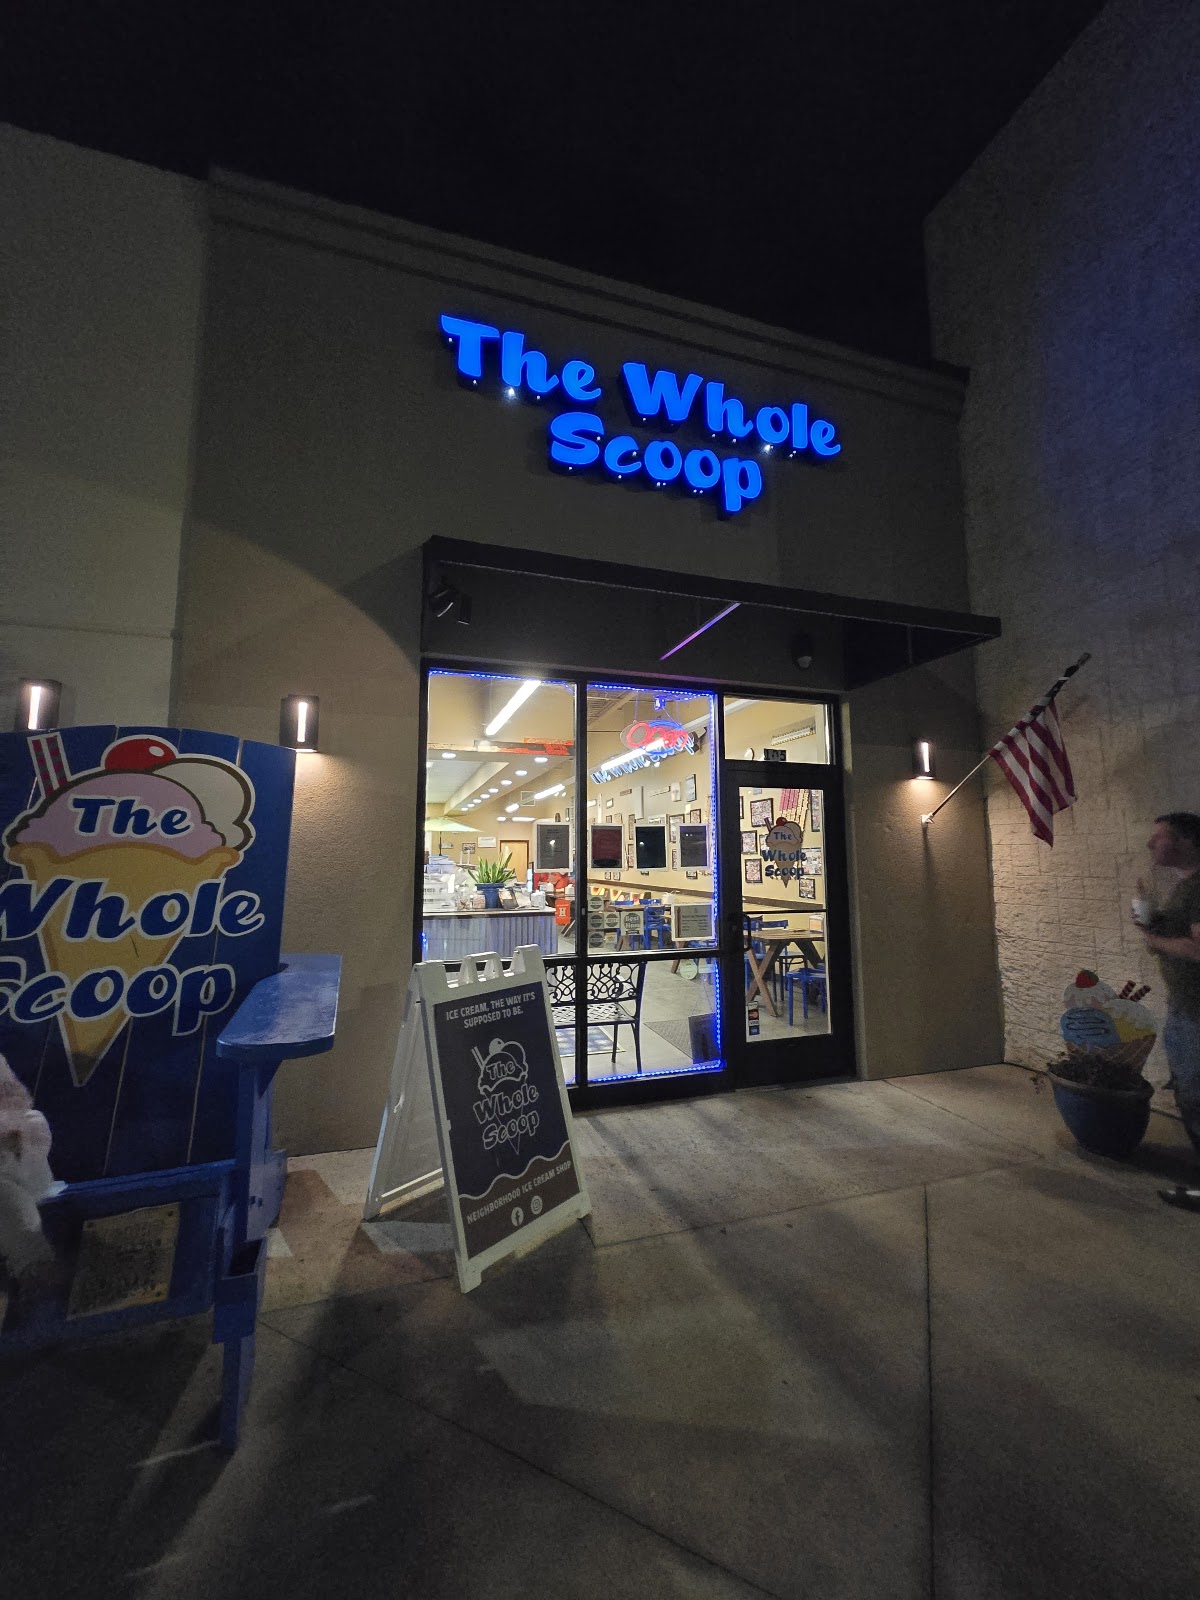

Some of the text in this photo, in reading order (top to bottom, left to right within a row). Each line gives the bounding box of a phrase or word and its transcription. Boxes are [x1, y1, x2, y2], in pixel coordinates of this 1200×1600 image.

[441, 314, 841, 456] The Whole
[549, 411, 762, 512] Scoop
[627, 722, 689, 750] Open
[72, 796, 194, 837] The
[773, 832, 792, 840] The
[762, 850, 807, 861] Whole
[765, 865, 804, 880] Scoop
[0, 877, 264, 942] Whole
[446, 1009, 459, 1021] ICE
[490, 999, 505, 1009] THE
[505, 994, 522, 1006] WAY
[523, 991, 536, 1002] IT'S
[464, 1006, 524, 1029] SUPPOSED TO BE.
[486, 1061, 515, 1080] The
[473, 1083, 539, 1124] Whole
[482, 1110, 540, 1149] Scoop
[466, 1160, 572, 1225] NEIGHBORHOOD ICE CREAM SHOP
